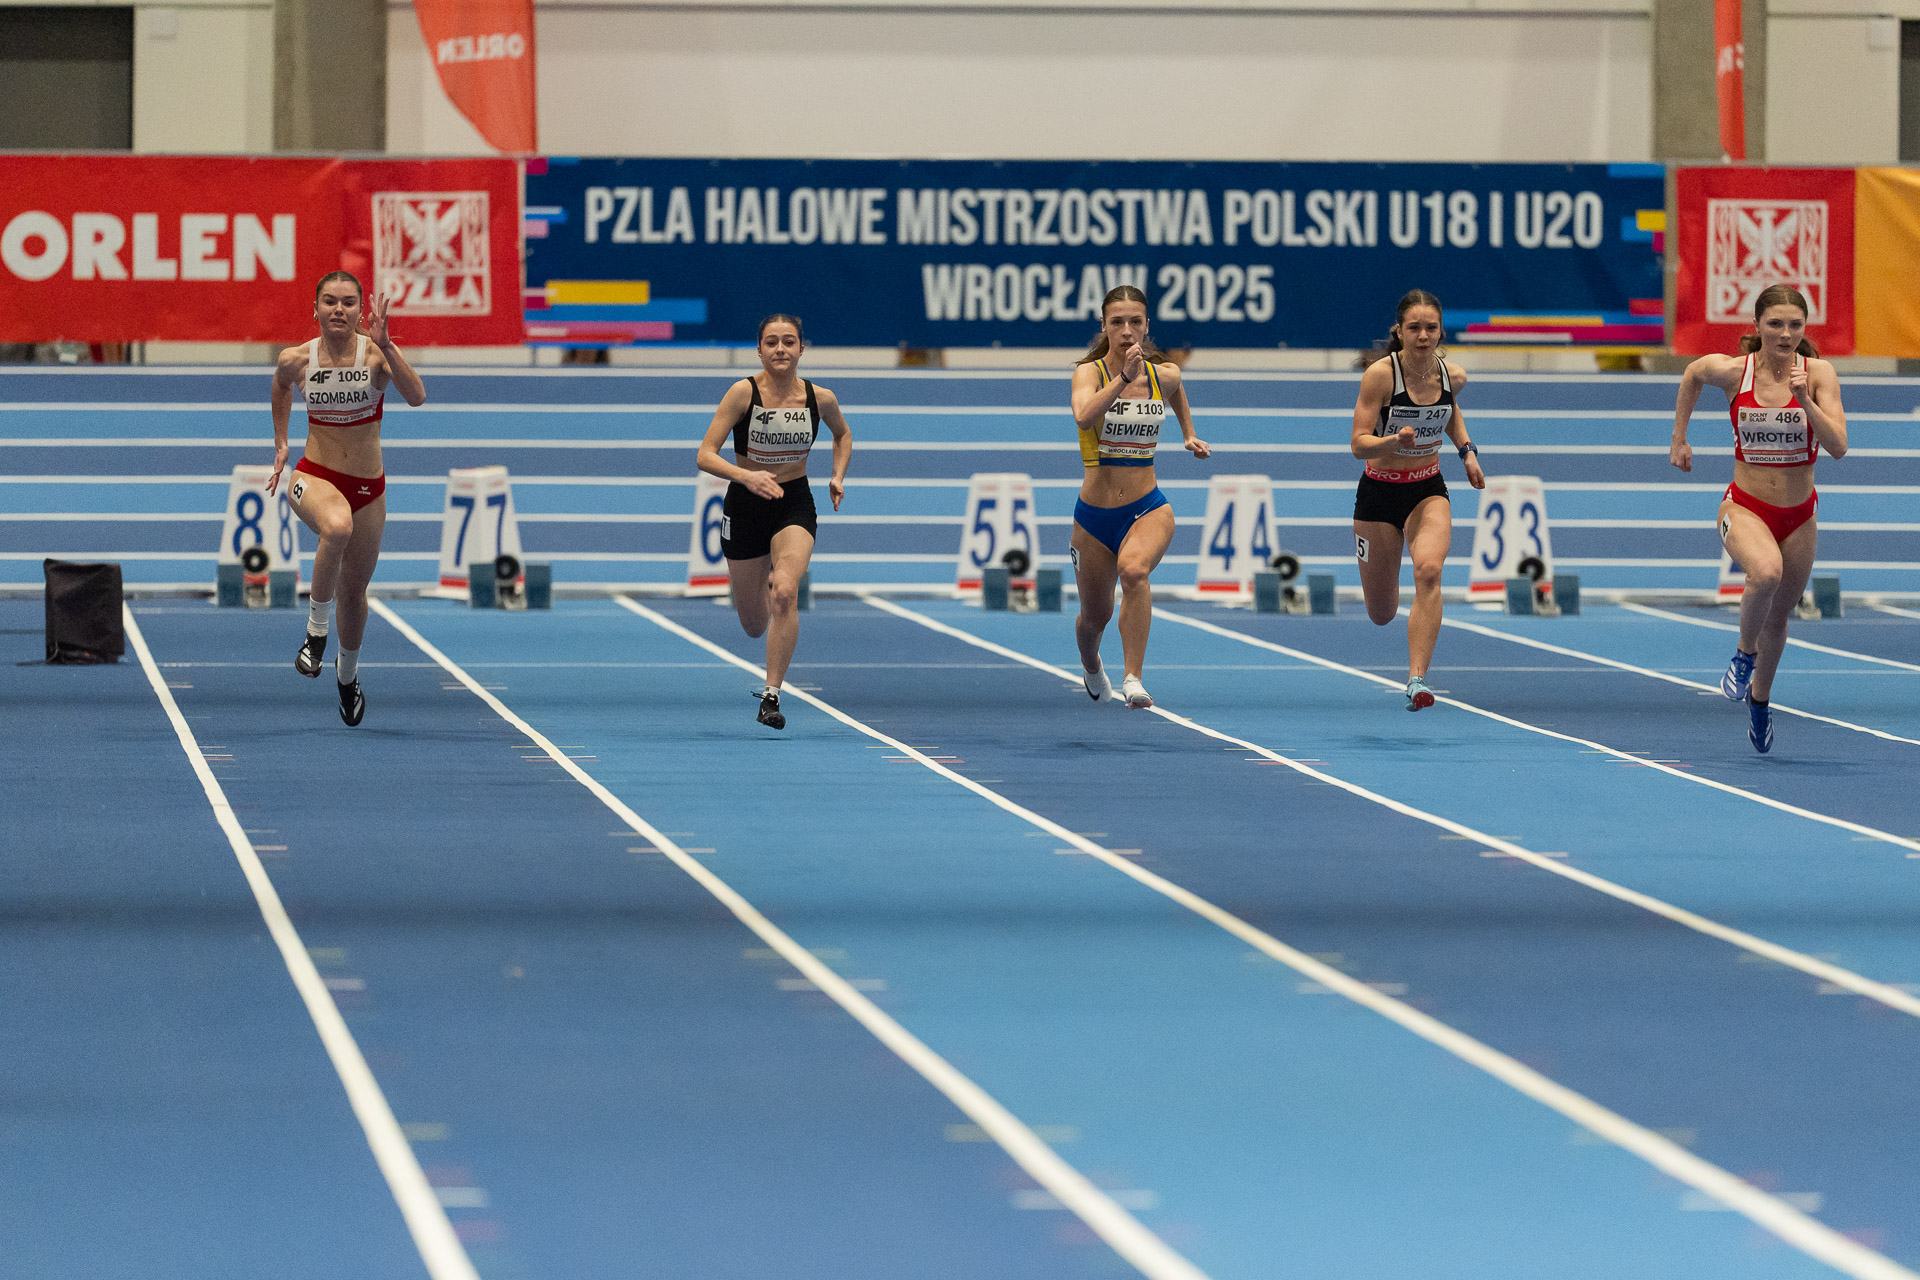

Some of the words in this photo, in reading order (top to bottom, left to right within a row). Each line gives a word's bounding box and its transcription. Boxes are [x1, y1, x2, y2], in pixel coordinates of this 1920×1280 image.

[1, 210, 296, 281] ORLEN
[585, 187, 695, 243] PZLA
[705, 187, 888, 245] HALOWE
[896, 188, 1213, 247] MISTRZOSTWA
[1223, 189, 1379, 247] POLSKI
[1389, 190, 1479, 248] U18
[1489, 190, 1504, 248] I
[1514, 190, 1604, 249] U20
[382, 272, 482, 306] PZLA
[1157, 263, 1274, 322] 2025
[309, 370, 333, 384] 4F
[338, 370, 368, 382] 1005
[309, 390, 369, 405] SZOMBARA
[755, 411, 777, 424] 4F
[784, 411, 806, 423] 944
[1105, 422, 1160, 436] SIEWIERA
[1108, 401, 1132, 415] 4F
[1136, 403, 1163, 415] 1103
[1425, 408, 1448, 420] 247
[1742, 430, 1804, 443] WROTEK
[1775, 411, 1801, 423] 486
[750, 430, 810, 445] SZENDZIELORZ
[293, 483, 303, 499] 8
[1368, 469, 1401, 480] PRO
[1407, 463, 1438, 480] NIKE
[232, 490, 264, 557] 8
[278, 490, 293, 562] 8
[450, 495, 476, 567] 7
[486, 492, 507, 558] 7
[702, 493, 725, 565] 6
[970, 498, 997, 568] 5
[1011, 498, 1031, 560] 5
[1208, 500, 1236, 571] 4
[1251, 501, 1272, 568] 4
[1357, 537, 1366, 558] 5
[1482, 501, 1505, 571] 3
[1520, 501, 1543, 558] 3
